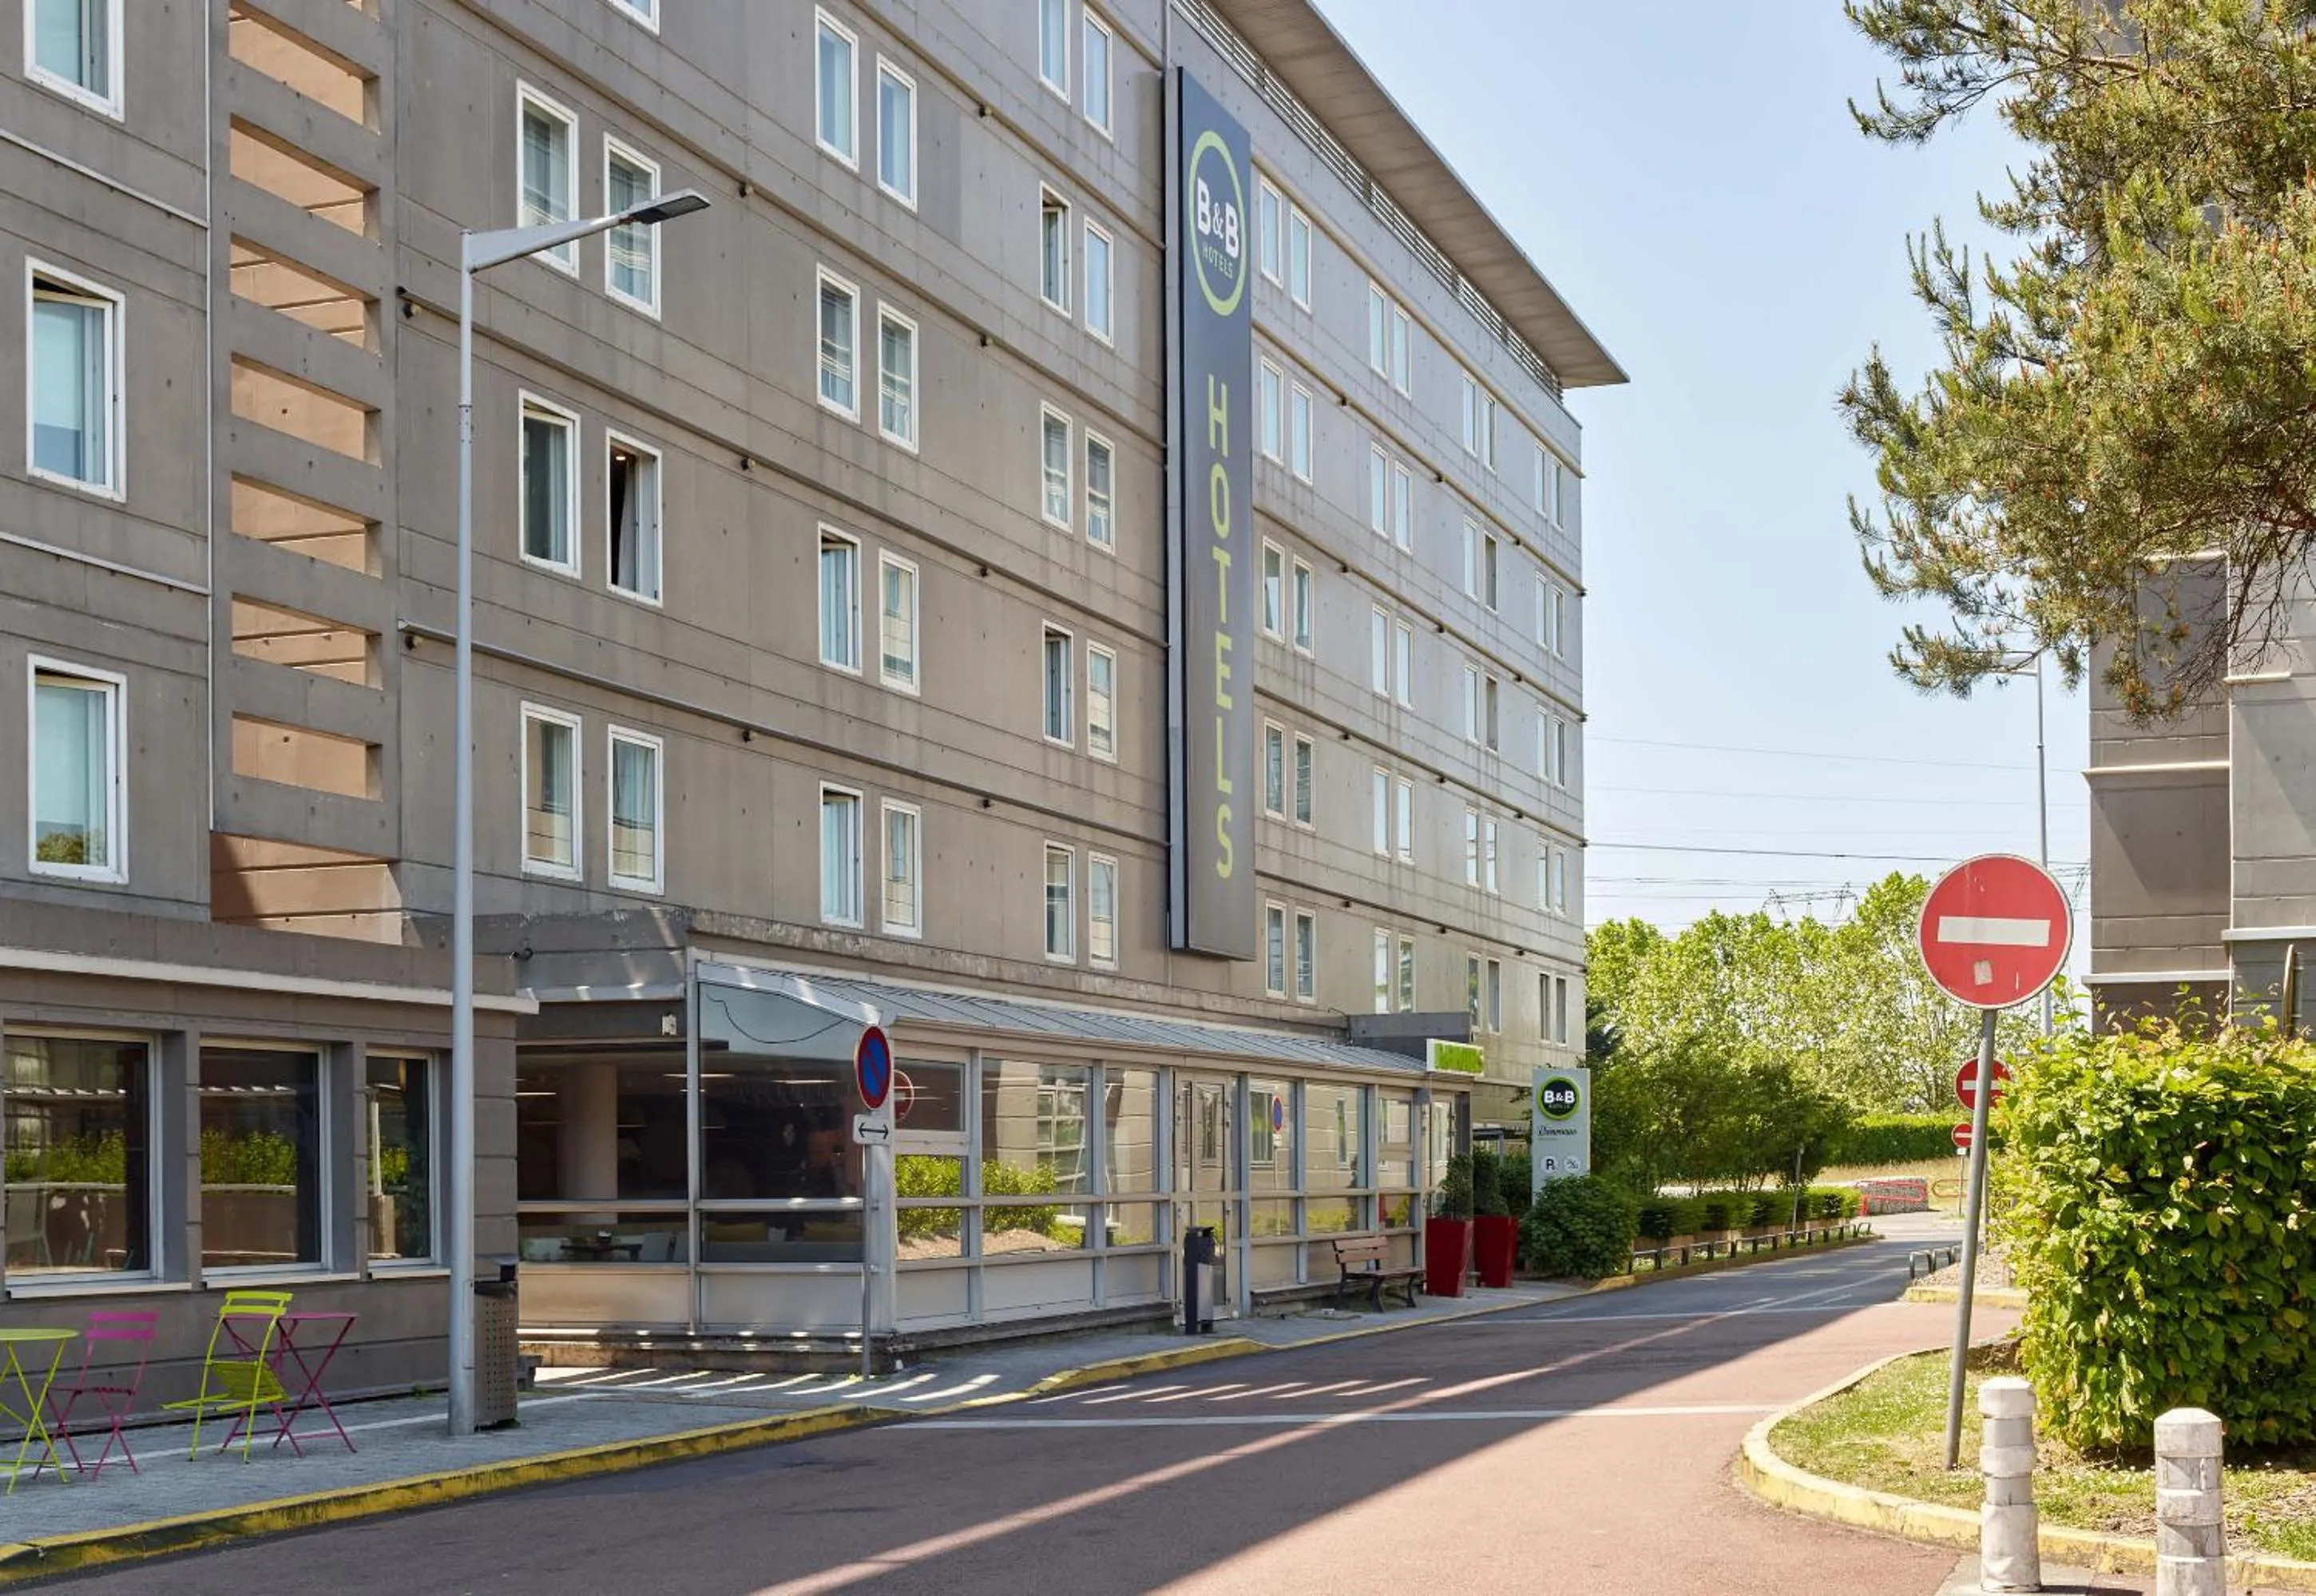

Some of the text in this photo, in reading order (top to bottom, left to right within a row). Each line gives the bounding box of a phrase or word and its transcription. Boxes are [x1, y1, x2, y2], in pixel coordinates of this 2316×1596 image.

[1197, 176, 1239, 258] B&B
[1202, 240, 1232, 279] HOTELS
[1208, 373, 1233, 879] HOTELS
[1544, 1090, 1575, 1103] B&B
